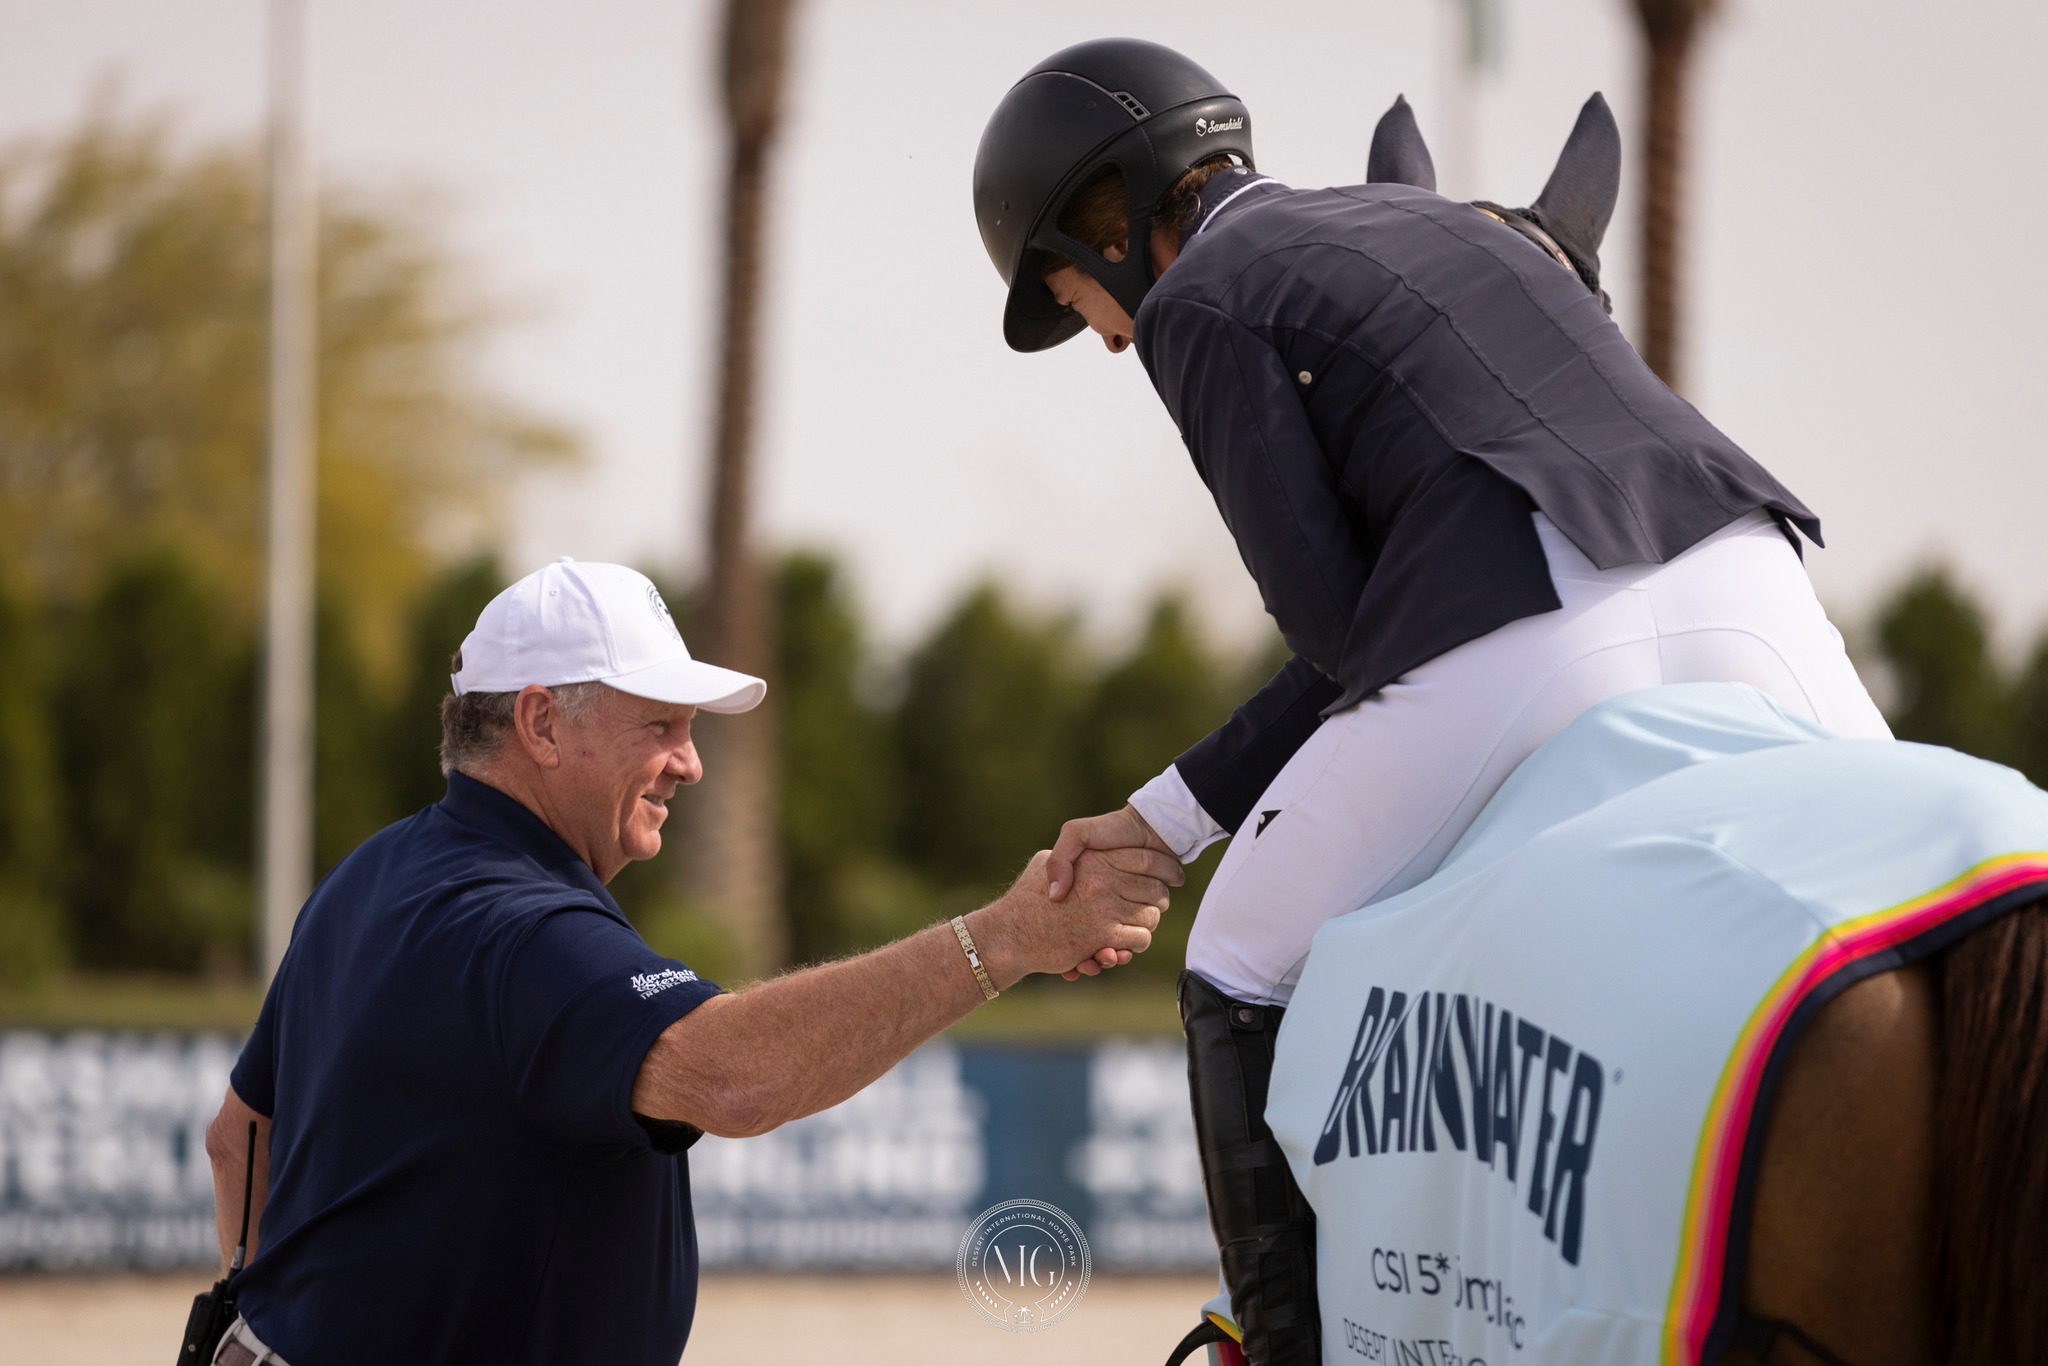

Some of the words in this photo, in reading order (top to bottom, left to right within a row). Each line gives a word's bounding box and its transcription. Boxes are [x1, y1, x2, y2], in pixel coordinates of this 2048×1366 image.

[1207, 116, 1244, 133] Samshield
[1313, 986, 1604, 1267] BRAINWATER
[1372, 1247, 1411, 1295] CSI
